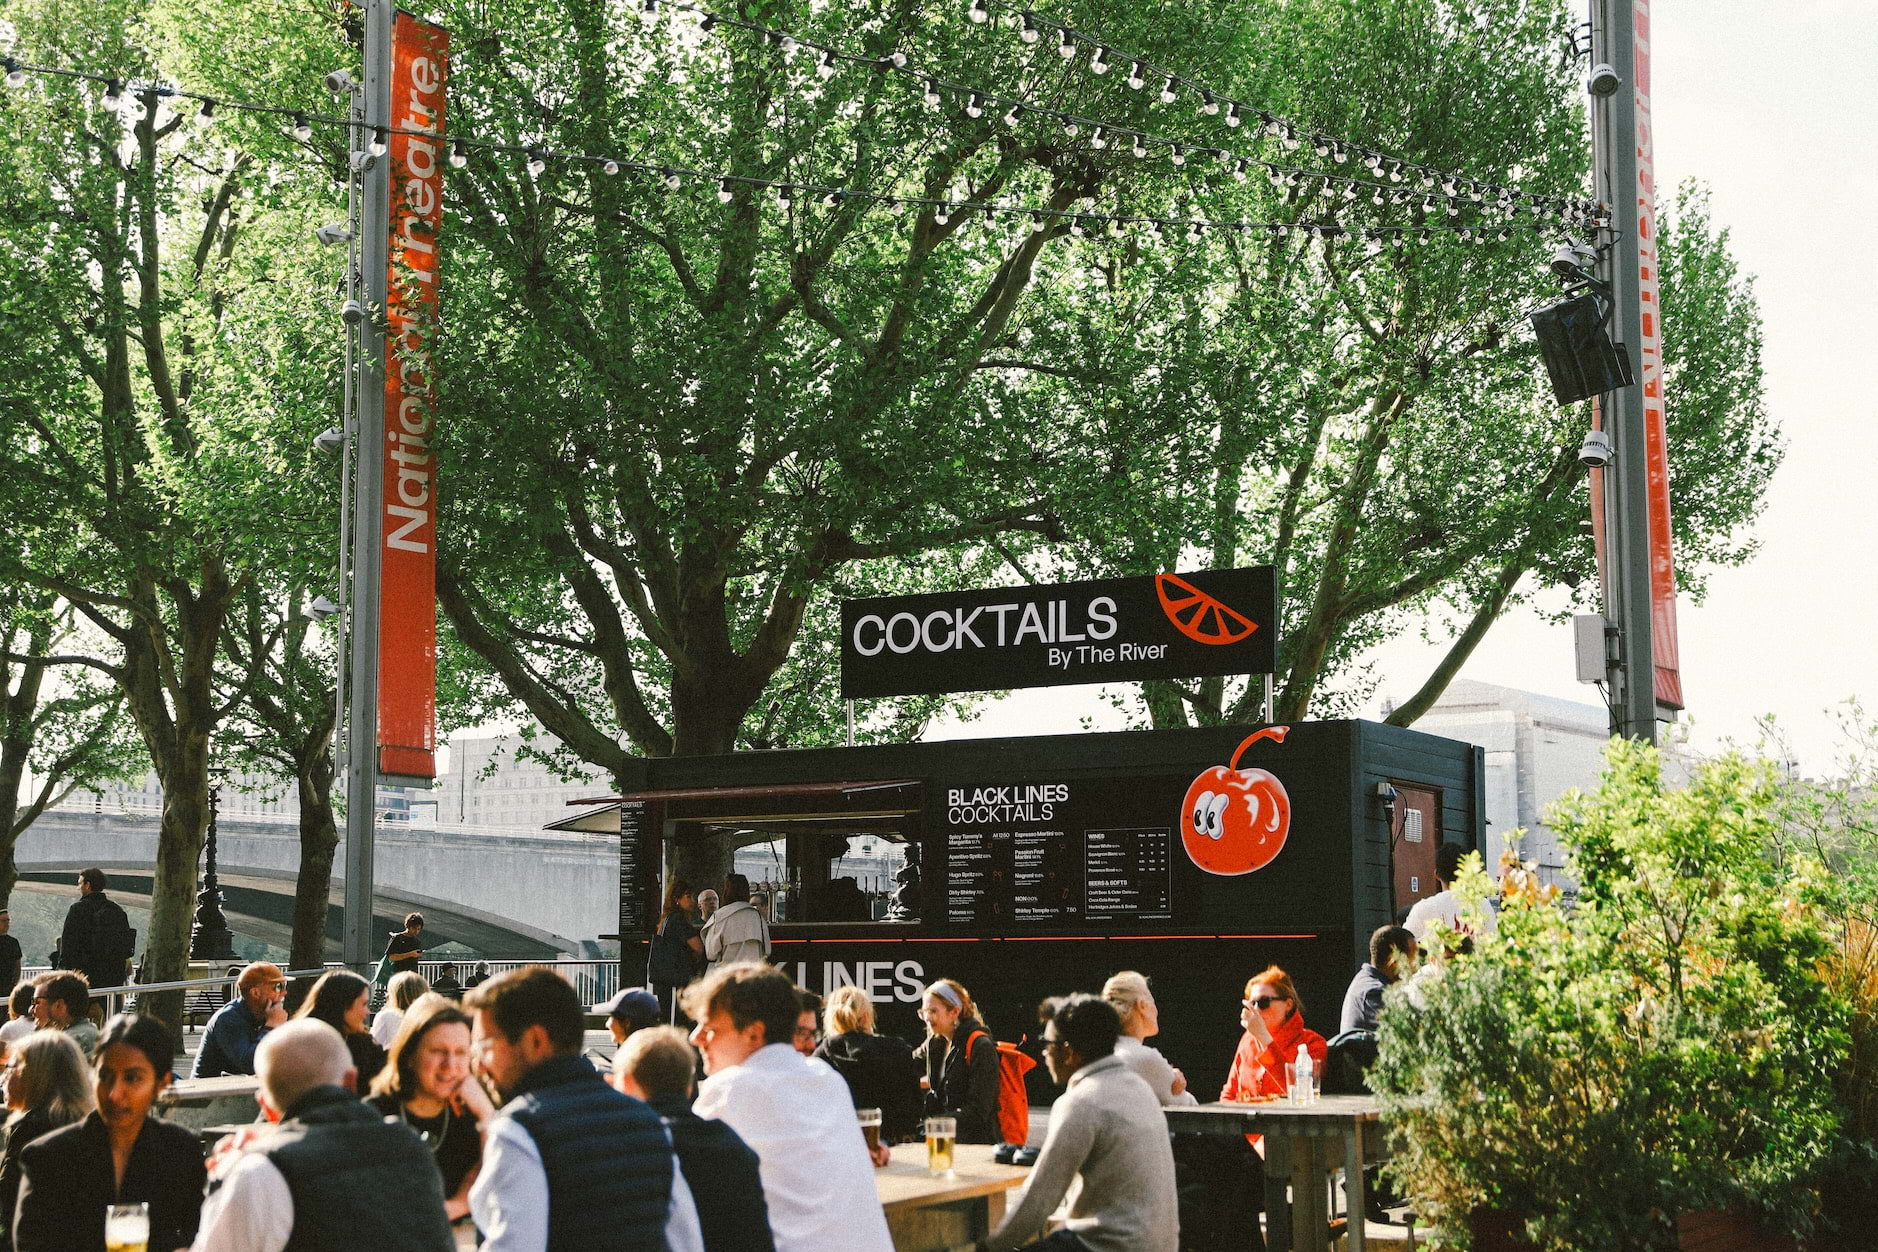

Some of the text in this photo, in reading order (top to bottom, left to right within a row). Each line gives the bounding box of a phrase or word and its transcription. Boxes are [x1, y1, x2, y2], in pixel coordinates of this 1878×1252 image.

[853, 596, 1118, 657] COCKTAILS
[1048, 642, 1168, 671] By The River
[948, 784, 1069, 807] BLACK LINES
[948, 803, 1054, 825] COCKTAILS
[797, 960, 926, 1003] LINES
